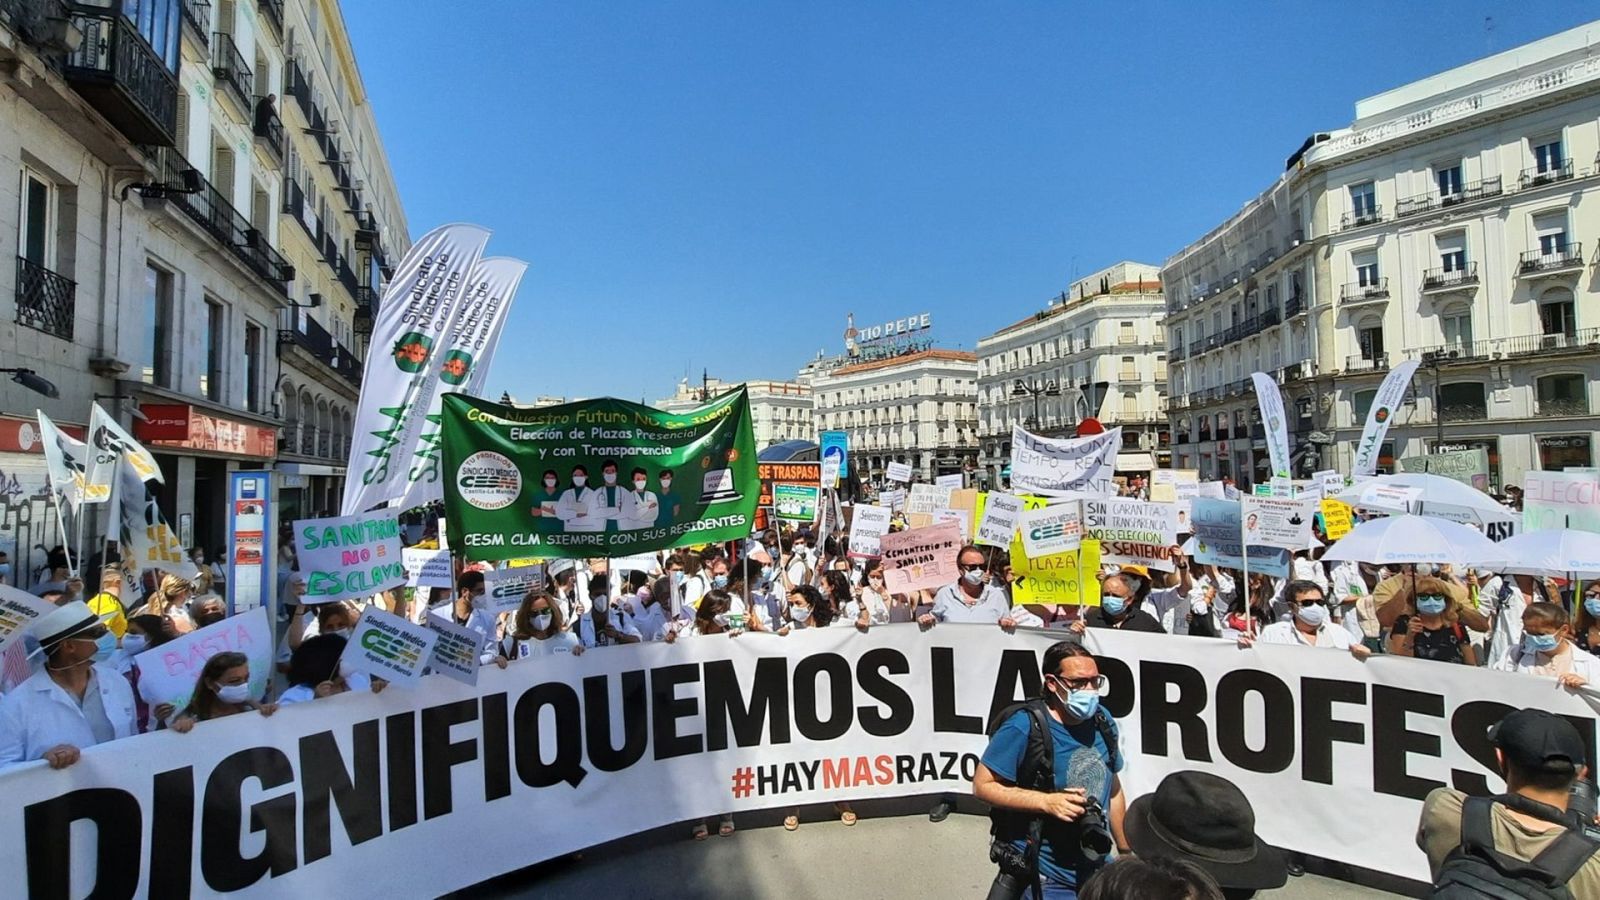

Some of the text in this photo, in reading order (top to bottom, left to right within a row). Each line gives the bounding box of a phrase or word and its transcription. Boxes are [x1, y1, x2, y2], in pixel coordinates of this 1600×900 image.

[402, 256, 433, 325] Sindicato
[418, 253, 449, 330] Médico de
[434, 271, 460, 332] Granada
[460, 281, 489, 347] Médico de
[474, 297, 499, 350] Granada
[859, 312, 931, 340] TIO PEPE
[144, 419, 186, 427] VIPS
[505, 411, 569, 424] Nuestro
[576, 410, 628, 424] Futuro
[510, 427, 697, 440] Elección de Plazas Presencial
[538, 444, 673, 460] y con Transparencia
[1074, 454, 1112, 470] REAL
[462, 467, 495, 476] SINDICATO
[758, 465, 771, 479] SE
[772, 465, 820, 479] TRASPASA
[1087, 502, 1107, 514] SIN
[464, 514, 746, 546] CESM CLM SIEMPRE CON SUS RESIDENTES
[1088, 515, 1106, 527] SIN
[303, 519, 398, 550] SANITARIO
[1087, 528, 1104, 541] NO
[1105, 529, 1116, 541] ES
[341, 548, 371, 566] NO
[885, 542, 940, 558] CEMENTERIO
[1100, 541, 1175, 561] S SENTENCIA
[896, 554, 935, 569] SANIDAD
[306, 561, 405, 596] ESCLAVO
[1029, 576, 1078, 593] PLOMO
[364, 615, 427, 648] Sindicato Médico
[163, 623, 254, 677] BASTA
[24, 647, 915, 900] DIGNIFIQUEMOS
[1096, 655, 1598, 801] PROFES
